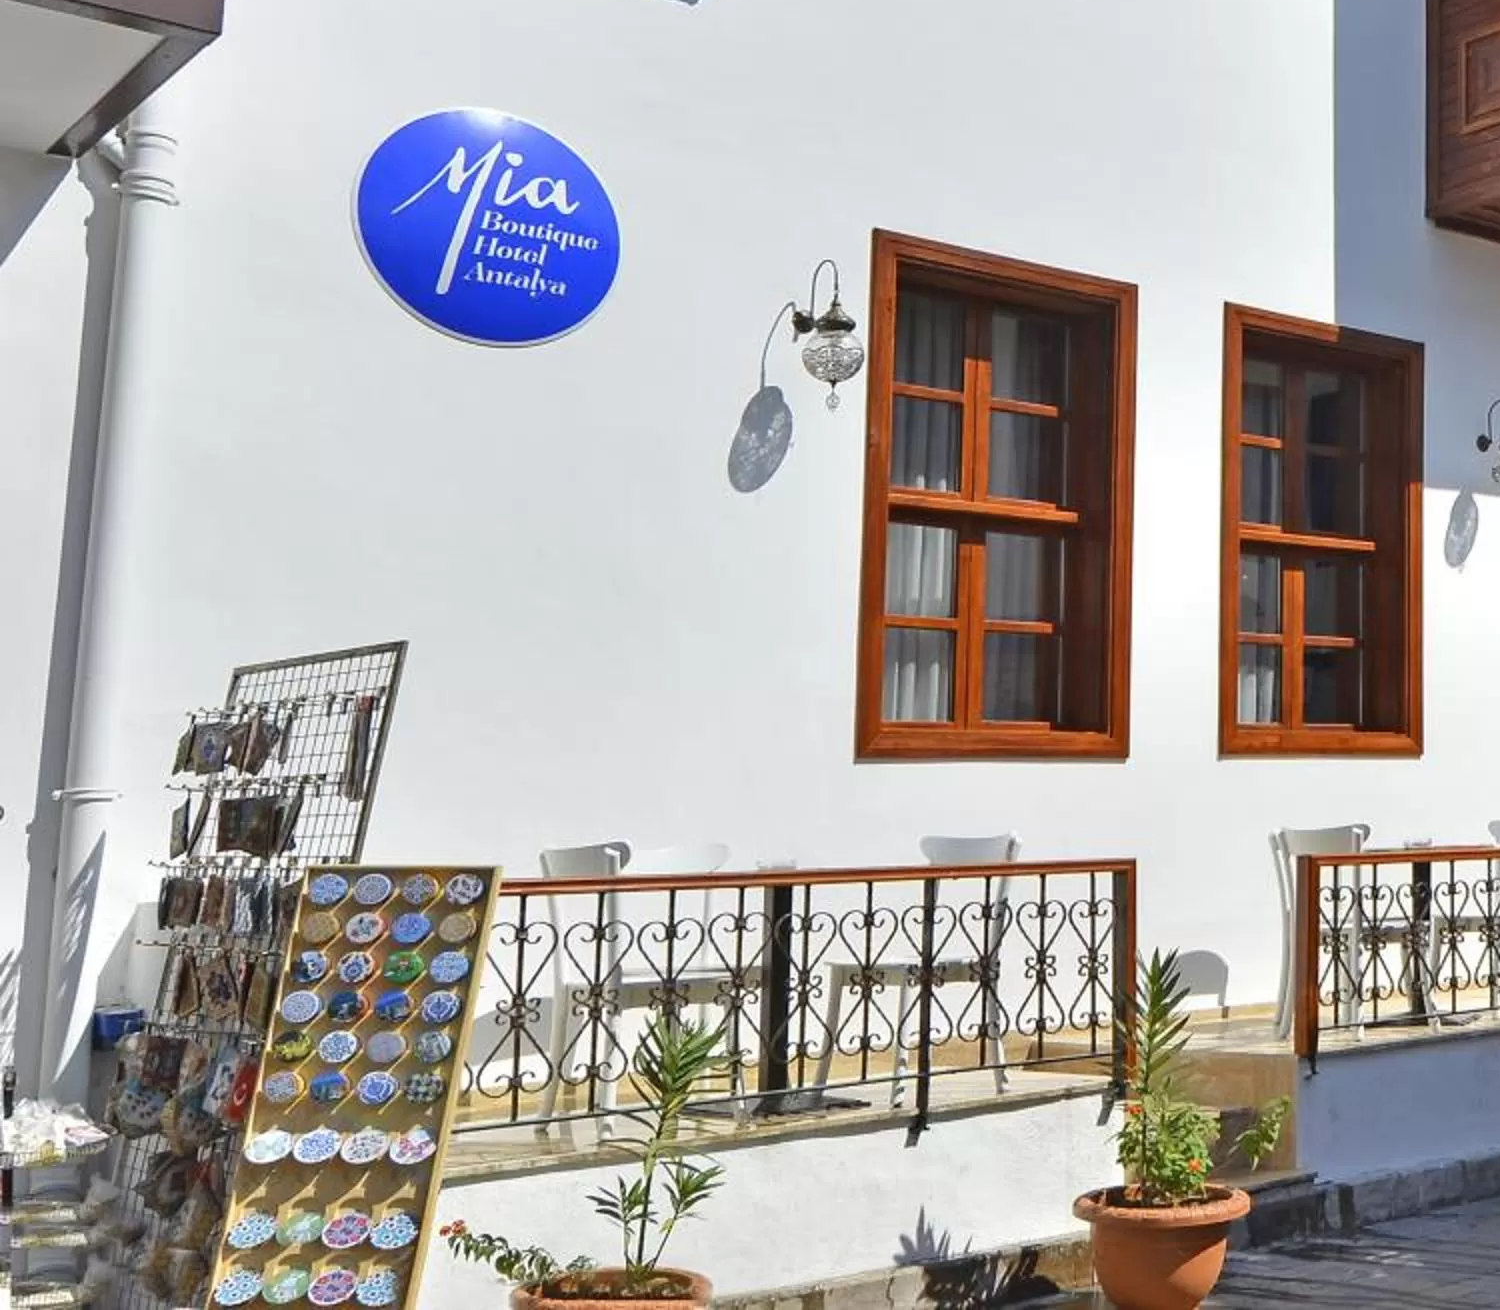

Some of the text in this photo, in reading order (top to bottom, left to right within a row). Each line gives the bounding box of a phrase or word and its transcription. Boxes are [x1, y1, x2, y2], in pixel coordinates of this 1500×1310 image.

[391, 141, 579, 295] Mia
[481, 209, 600, 252] Boutique
[473, 234, 548, 266] Hotel
[464, 261, 567, 298] Antalya
